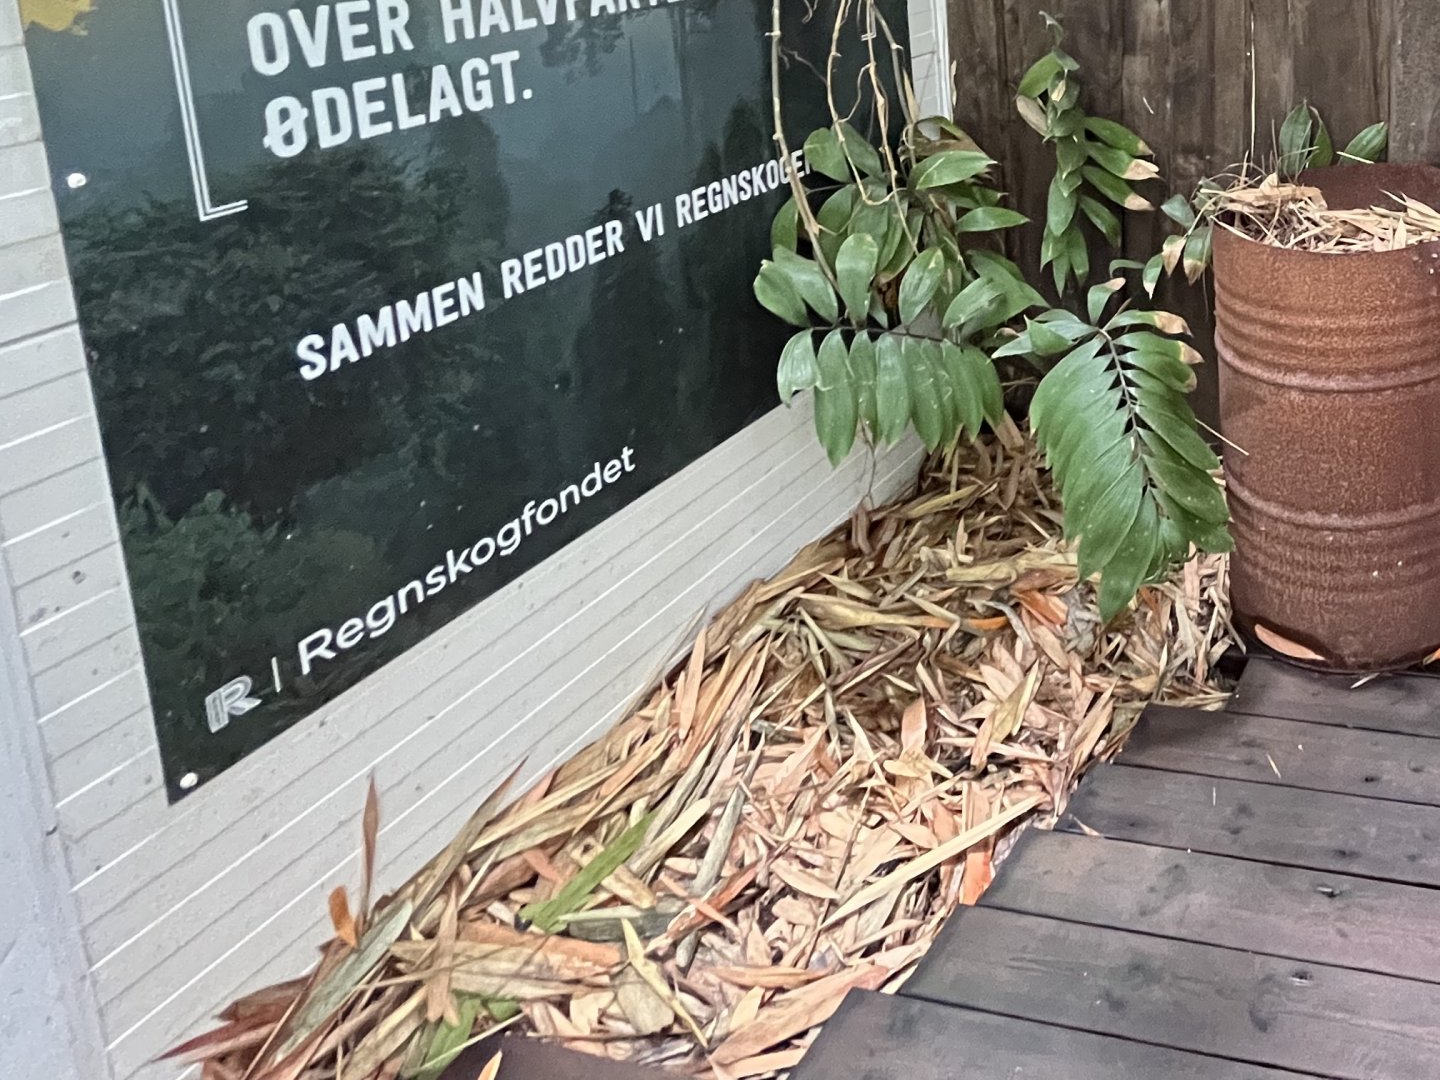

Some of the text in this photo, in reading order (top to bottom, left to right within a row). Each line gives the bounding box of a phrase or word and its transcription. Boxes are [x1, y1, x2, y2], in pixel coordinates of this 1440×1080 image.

[262, 49, 533, 159] ØDELAGT.
[296, 271, 486, 382] SAMMEN
[499, 218, 626, 300] REDDER
[634, 202, 665, 243] VI
[298, 445, 637, 676] Regnskogfondet
